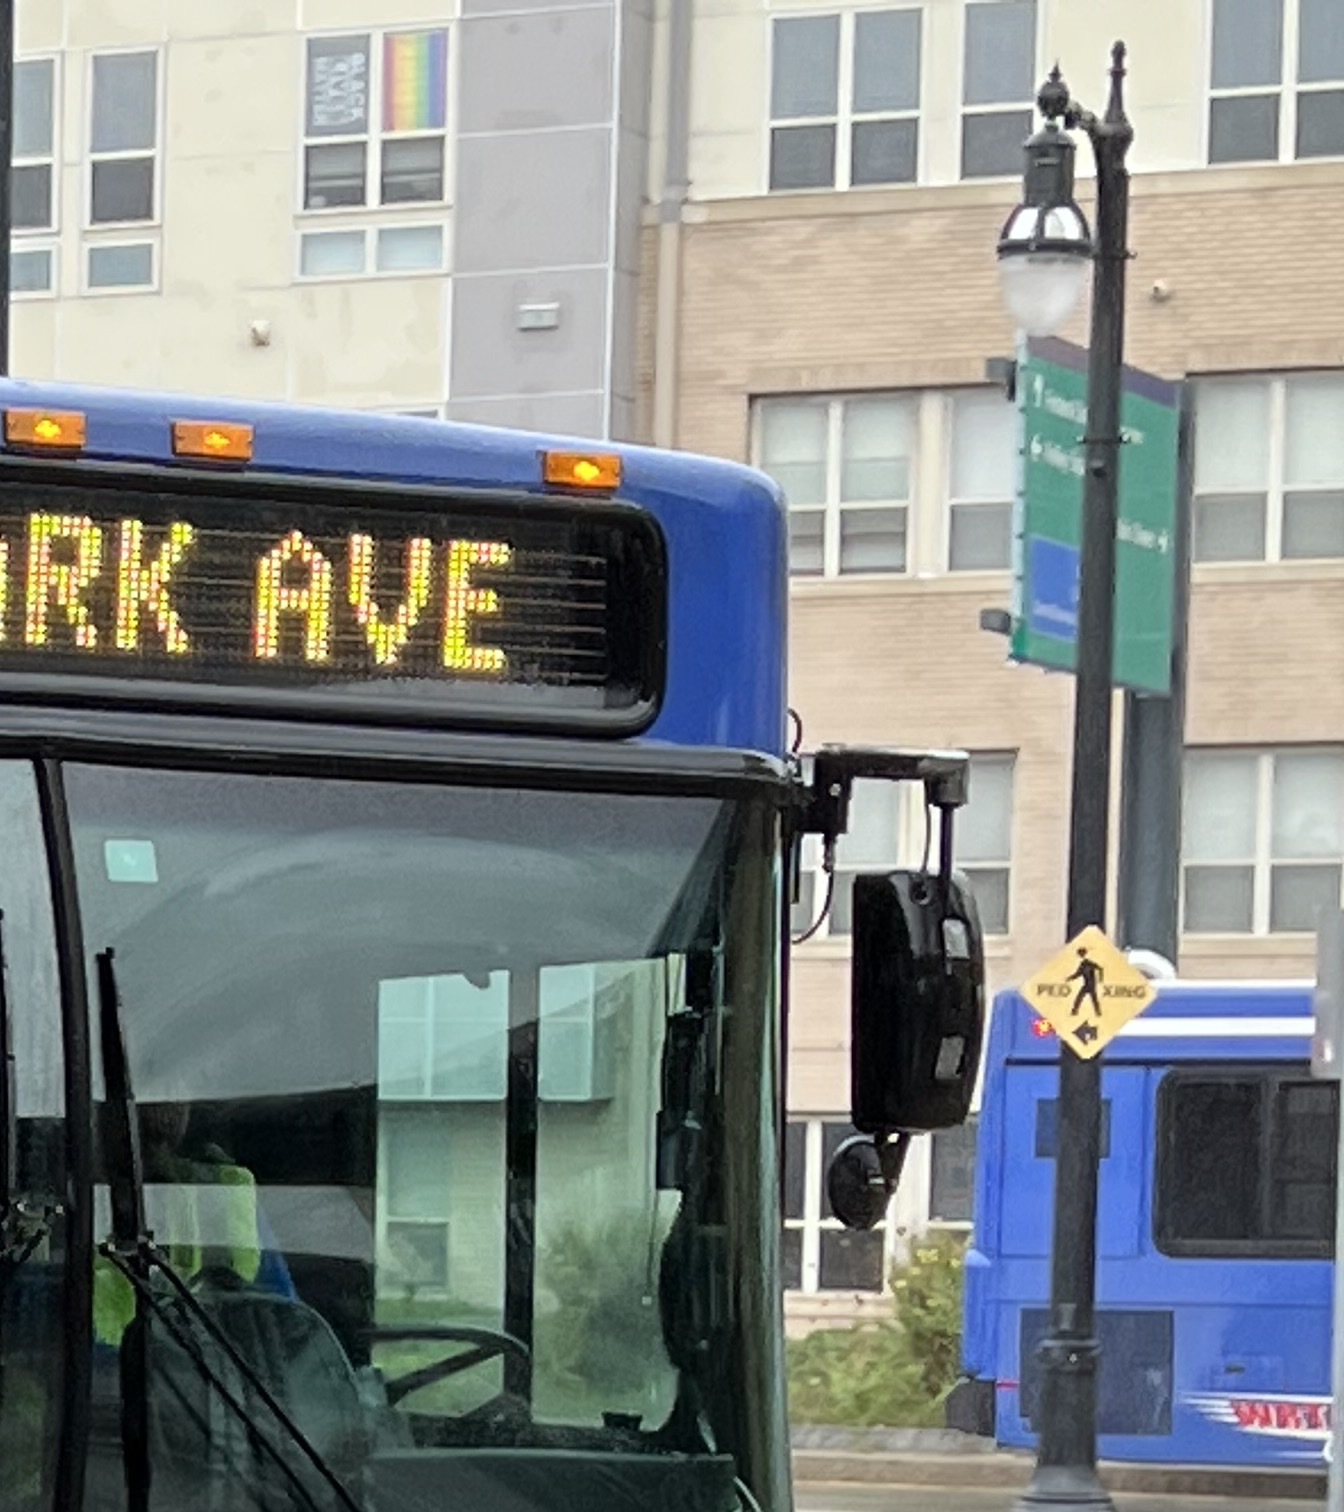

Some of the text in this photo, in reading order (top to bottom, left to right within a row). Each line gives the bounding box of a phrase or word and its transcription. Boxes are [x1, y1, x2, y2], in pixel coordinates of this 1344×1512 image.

[253, 527, 514, 676] AVE
[1037, 983, 1147, 999] PED XING
[1233, 1401, 1332, 1430] WRT
